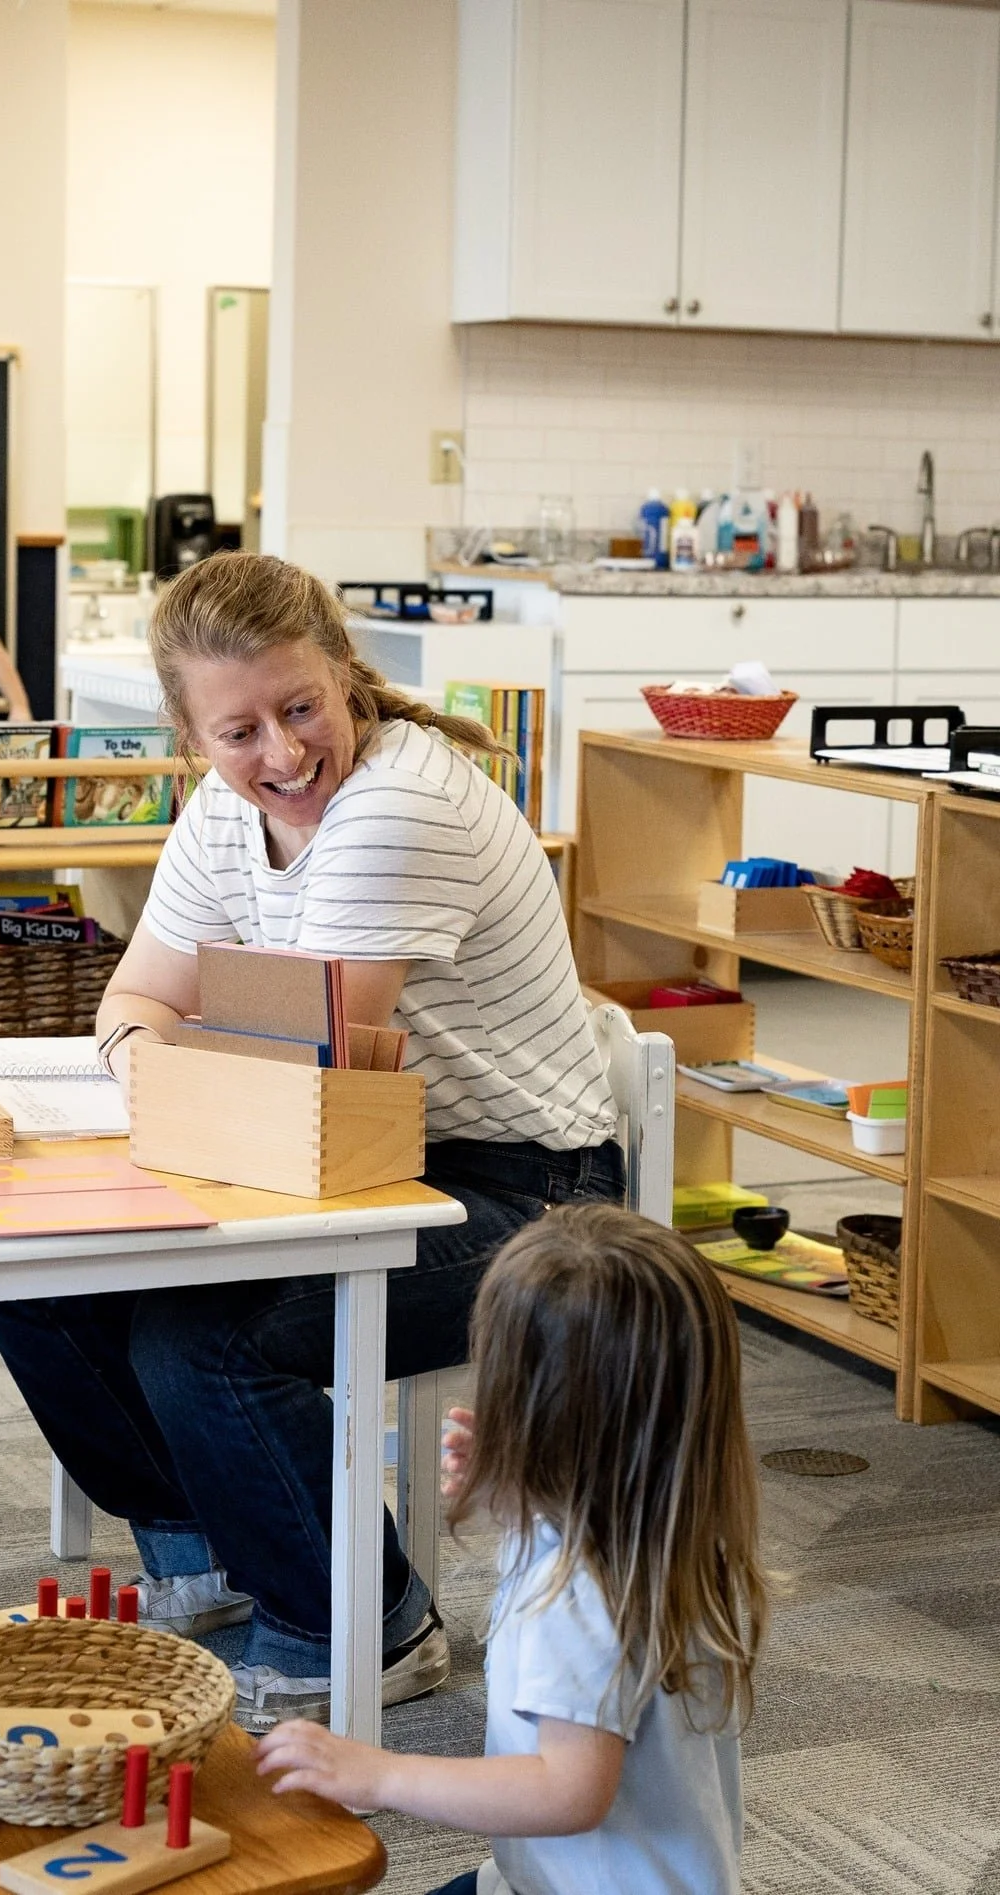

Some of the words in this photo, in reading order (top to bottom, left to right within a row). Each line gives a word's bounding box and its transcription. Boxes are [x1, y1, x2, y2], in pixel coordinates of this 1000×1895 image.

[104, 739, 118, 750] To
[121, 739, 142, 750] the
[1, 918, 22, 938] Big
[25, 921, 48, 936] Kid
[51, 923, 81, 941] Day
[43, 1842, 129, 1880] 2
